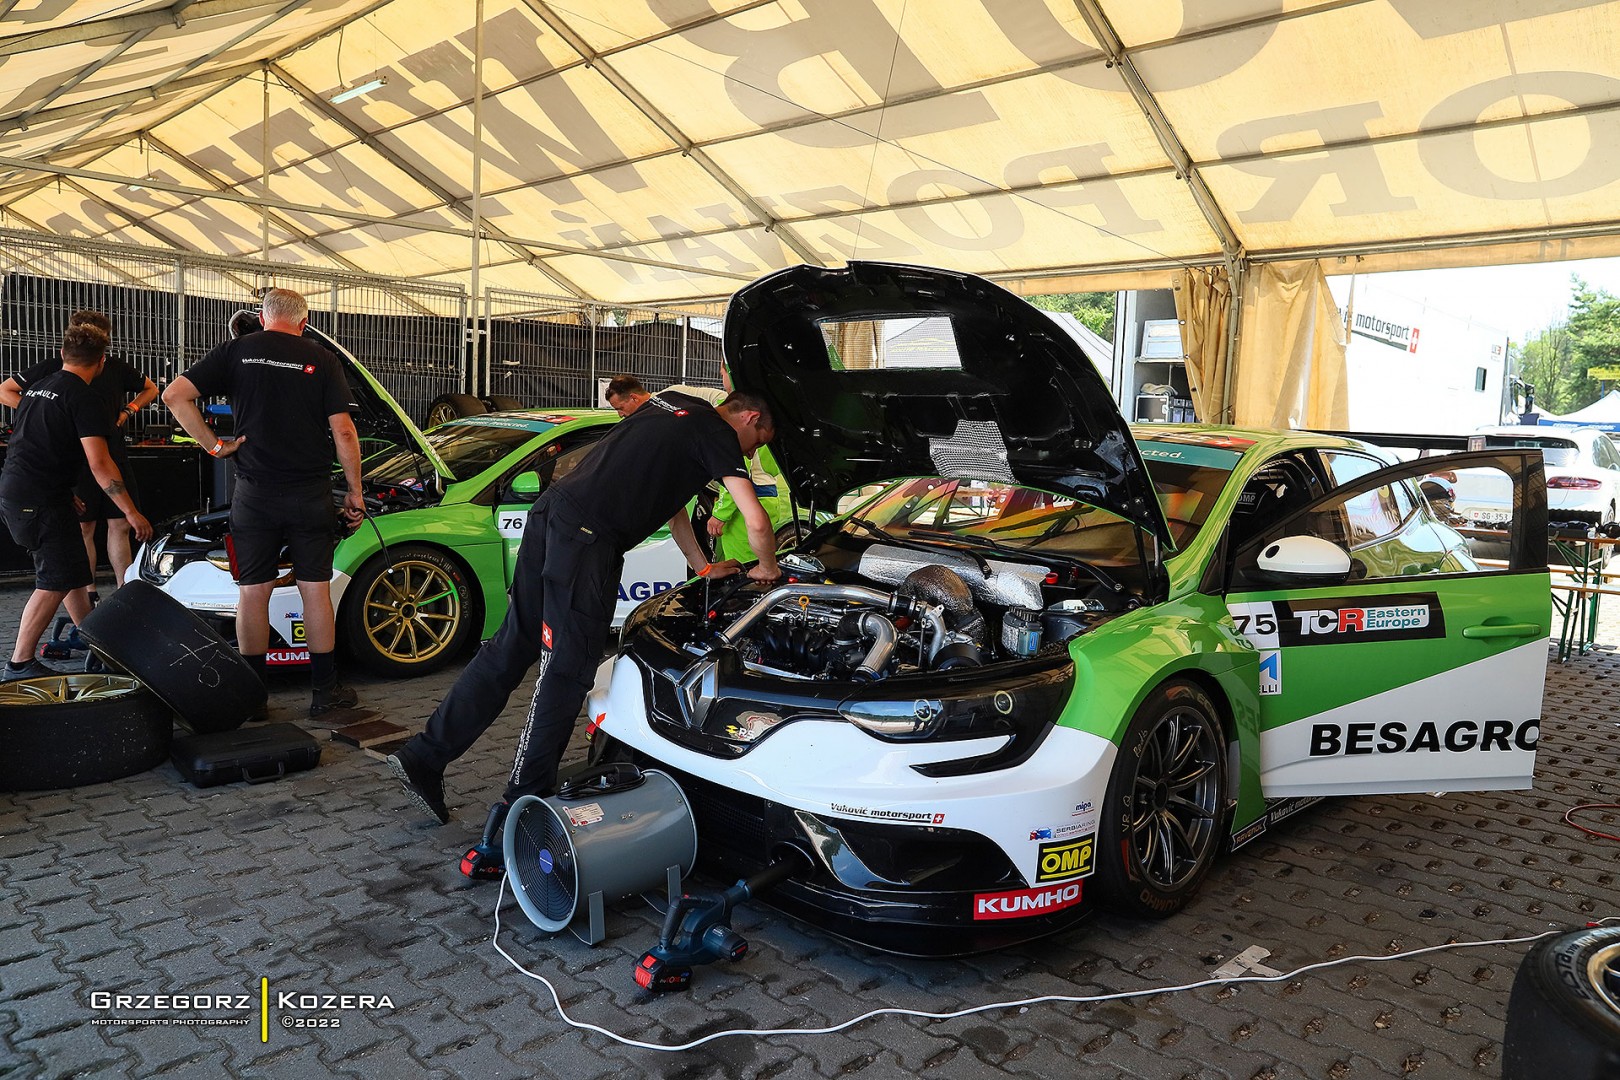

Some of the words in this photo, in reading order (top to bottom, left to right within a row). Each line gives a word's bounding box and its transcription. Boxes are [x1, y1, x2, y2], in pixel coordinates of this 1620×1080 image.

[1355, 312, 1410, 341] motorsport
[25, 389, 59, 400] REAULT
[503, 517, 523, 530] 76
[1366, 606, 1426, 619] Eastern
[1232, 613, 1277, 636] 75
[1293, 608, 1365, 636] TCR
[1366, 616, 1421, 630] Europe
[738, 726, 755, 739] RS
[830, 802, 869, 815] Vuković
[870, 809, 932, 820] motorsport
[1075, 801, 1092, 812] mipa
[1041, 845, 1092, 873] OMP
[978, 884, 1080, 914] KUMHO
